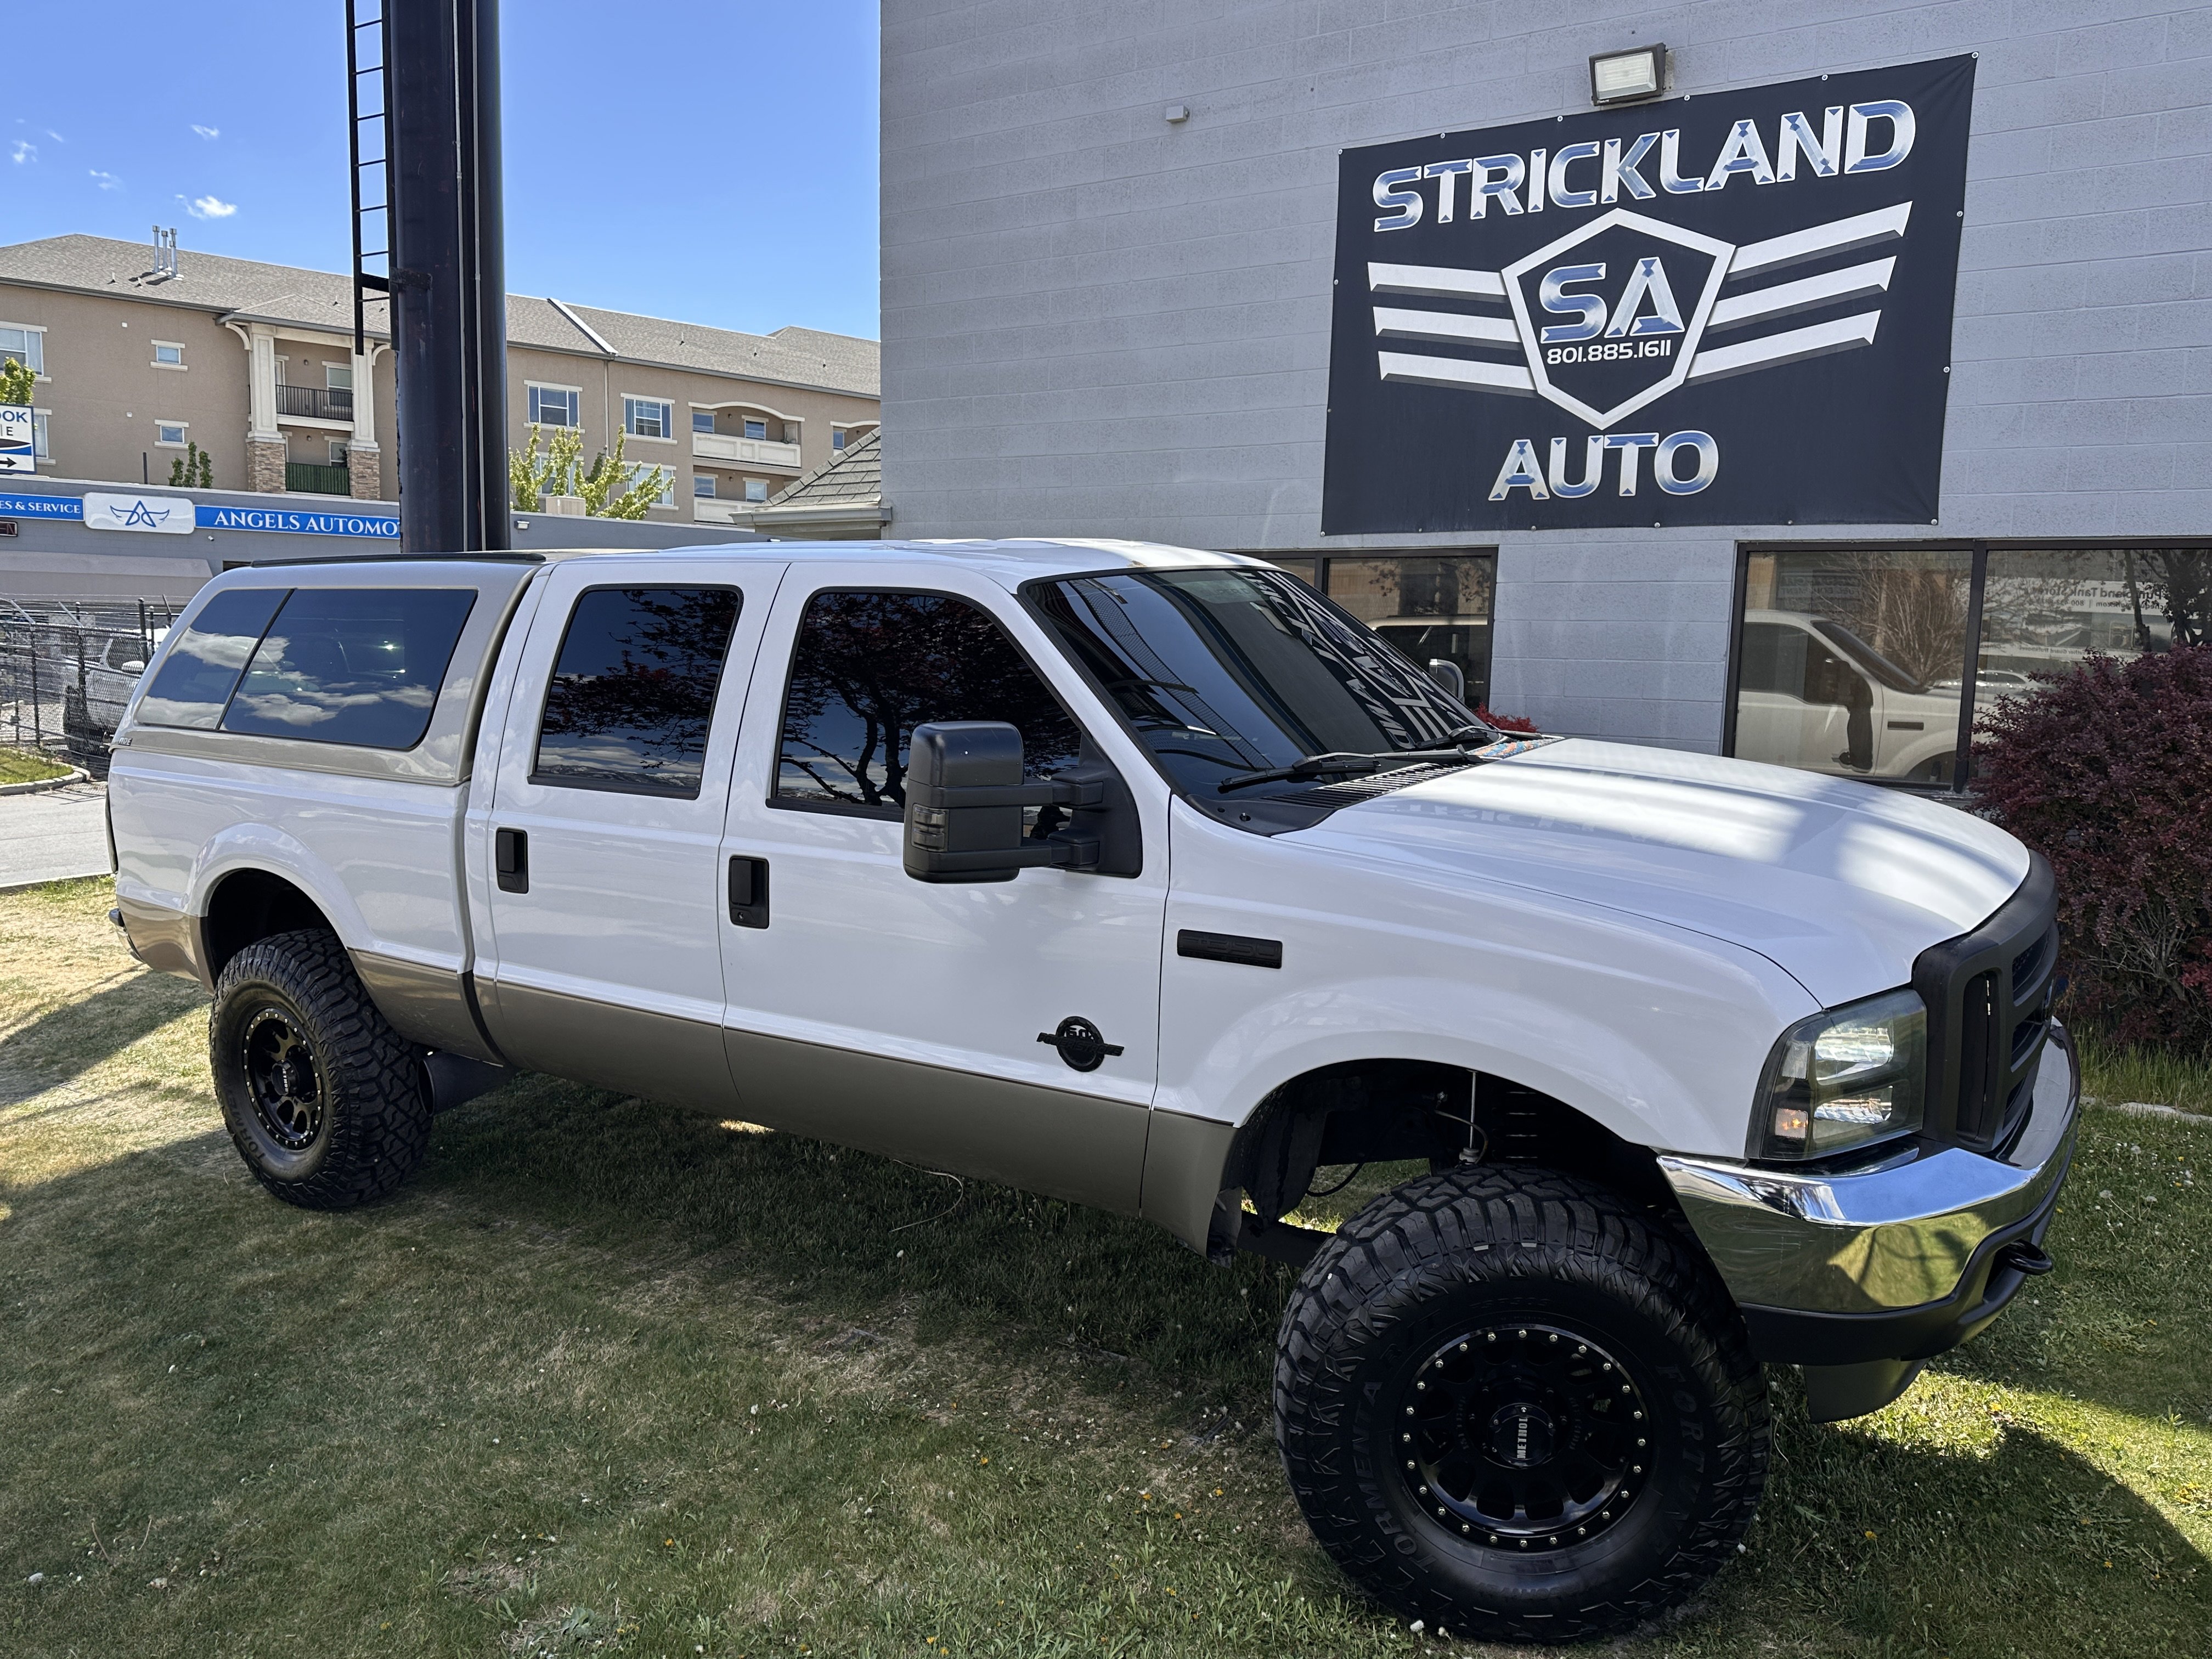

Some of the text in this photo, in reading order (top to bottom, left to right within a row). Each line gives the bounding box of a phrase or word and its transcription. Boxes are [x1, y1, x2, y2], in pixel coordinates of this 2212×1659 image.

[1372, 99, 1916, 233] STRICKLAND
[1539, 256, 1686, 345] SA
[1546, 341, 1672, 366] 801.885.1611
[0, 410, 28, 423] OK
[1488, 430, 1719, 501] AUTO
[15, 501, 26, 510] &
[28, 502, 81, 514] SERVICE
[214, 511, 300, 530] ANGELS
